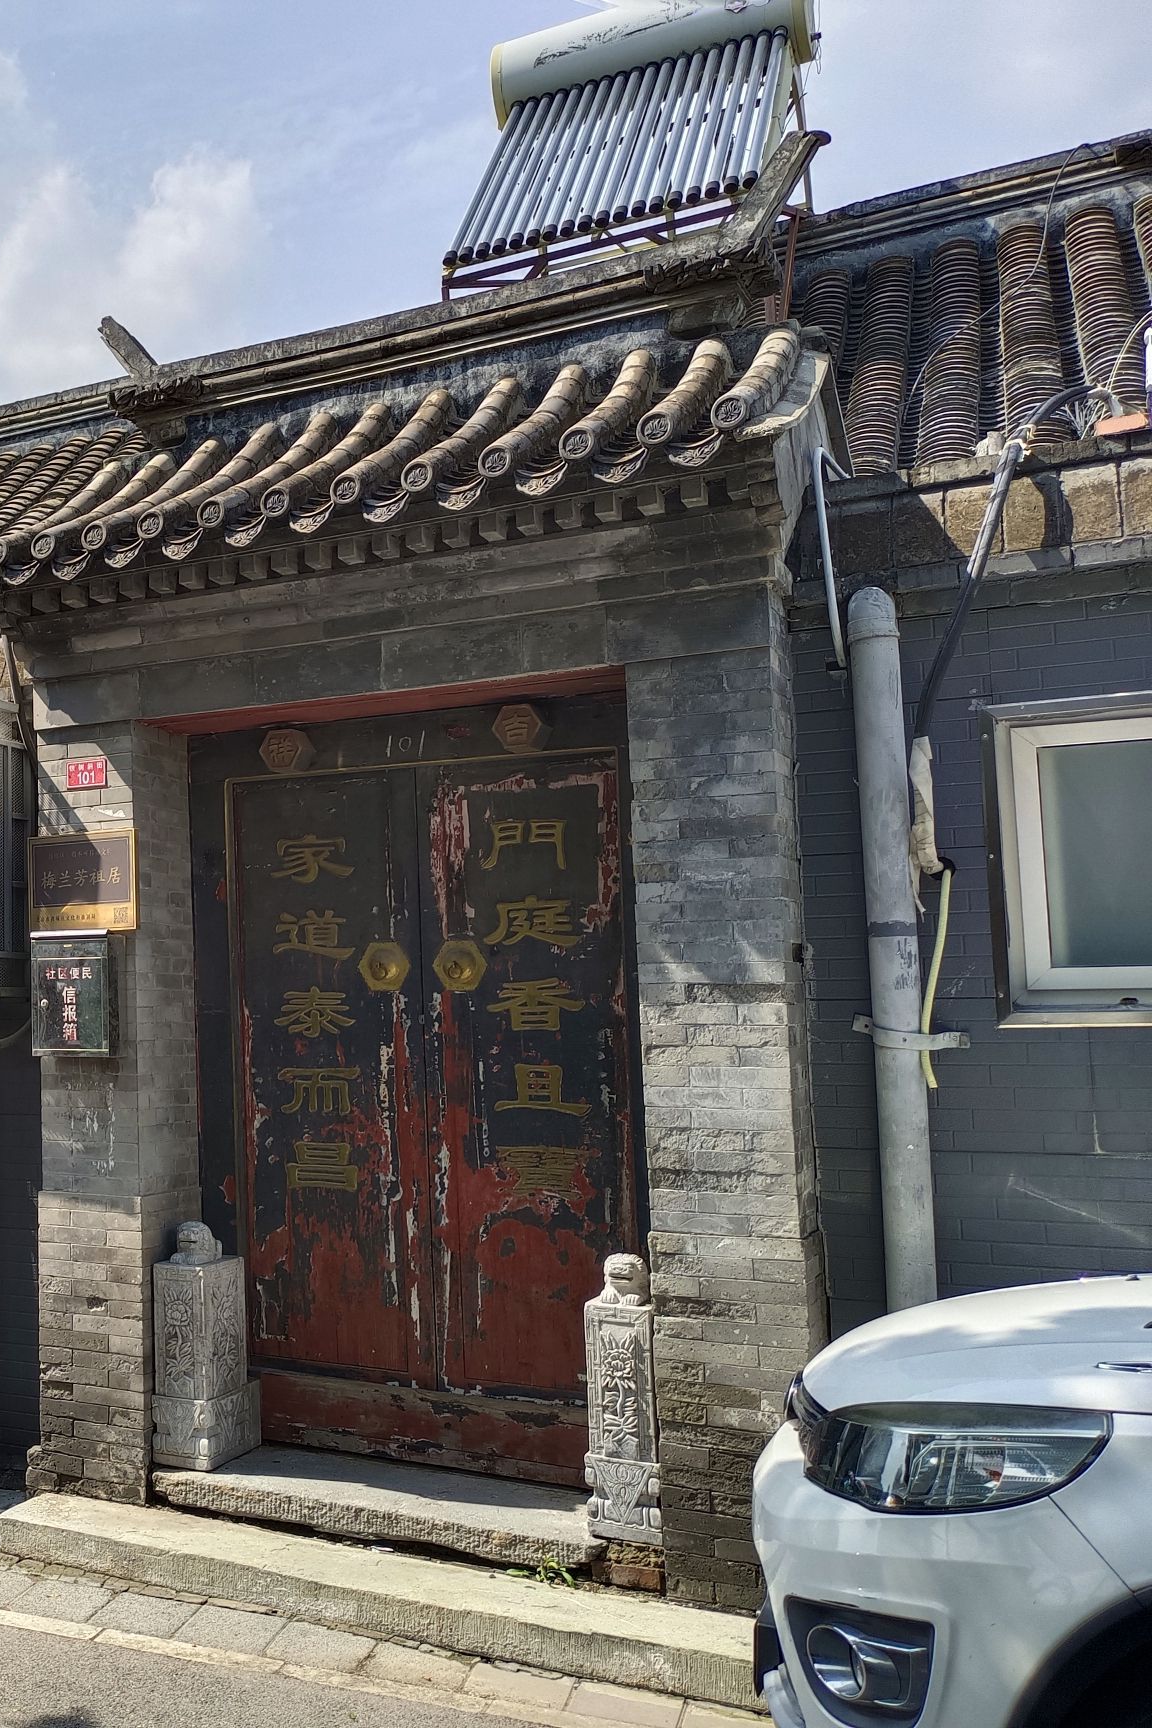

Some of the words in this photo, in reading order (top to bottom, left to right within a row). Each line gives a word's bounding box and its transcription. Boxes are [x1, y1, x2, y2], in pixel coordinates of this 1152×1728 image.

[386, 729, 426, 759] 101
[77, 770, 95, 785] 101
[41, 866, 122, 889] 梅兰芳祖居
[45, 966, 92, 980] 社区便民
[62, 986, 77, 1041] 信报箱
[270, 834, 360, 1192] 家道泰而昌
